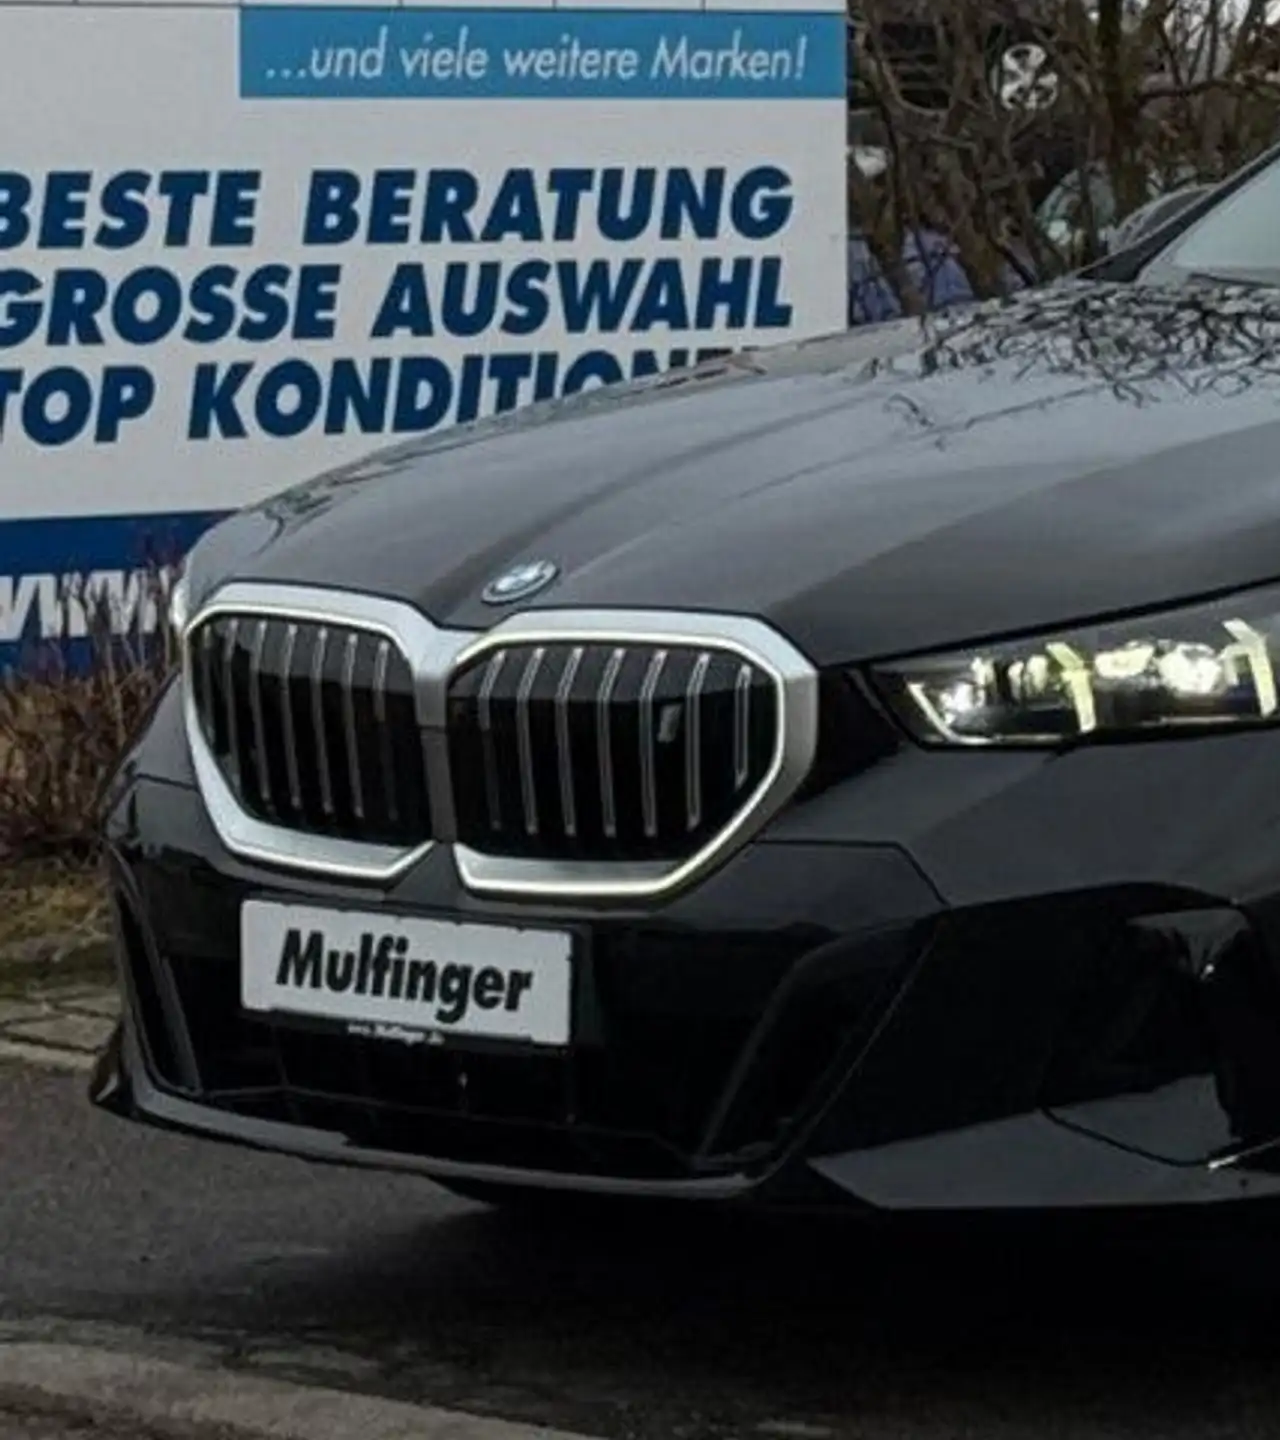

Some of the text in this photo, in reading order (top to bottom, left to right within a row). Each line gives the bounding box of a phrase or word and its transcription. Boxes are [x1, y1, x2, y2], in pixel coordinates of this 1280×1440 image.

[266, 25, 807, 80] ...und viele weitere Marken!
[0, 167, 793, 250] BESTE BERATUNG
[0, 257, 792, 348] GROSSE AUSWAHL
[275, 930, 532, 1024] Mulfinger
